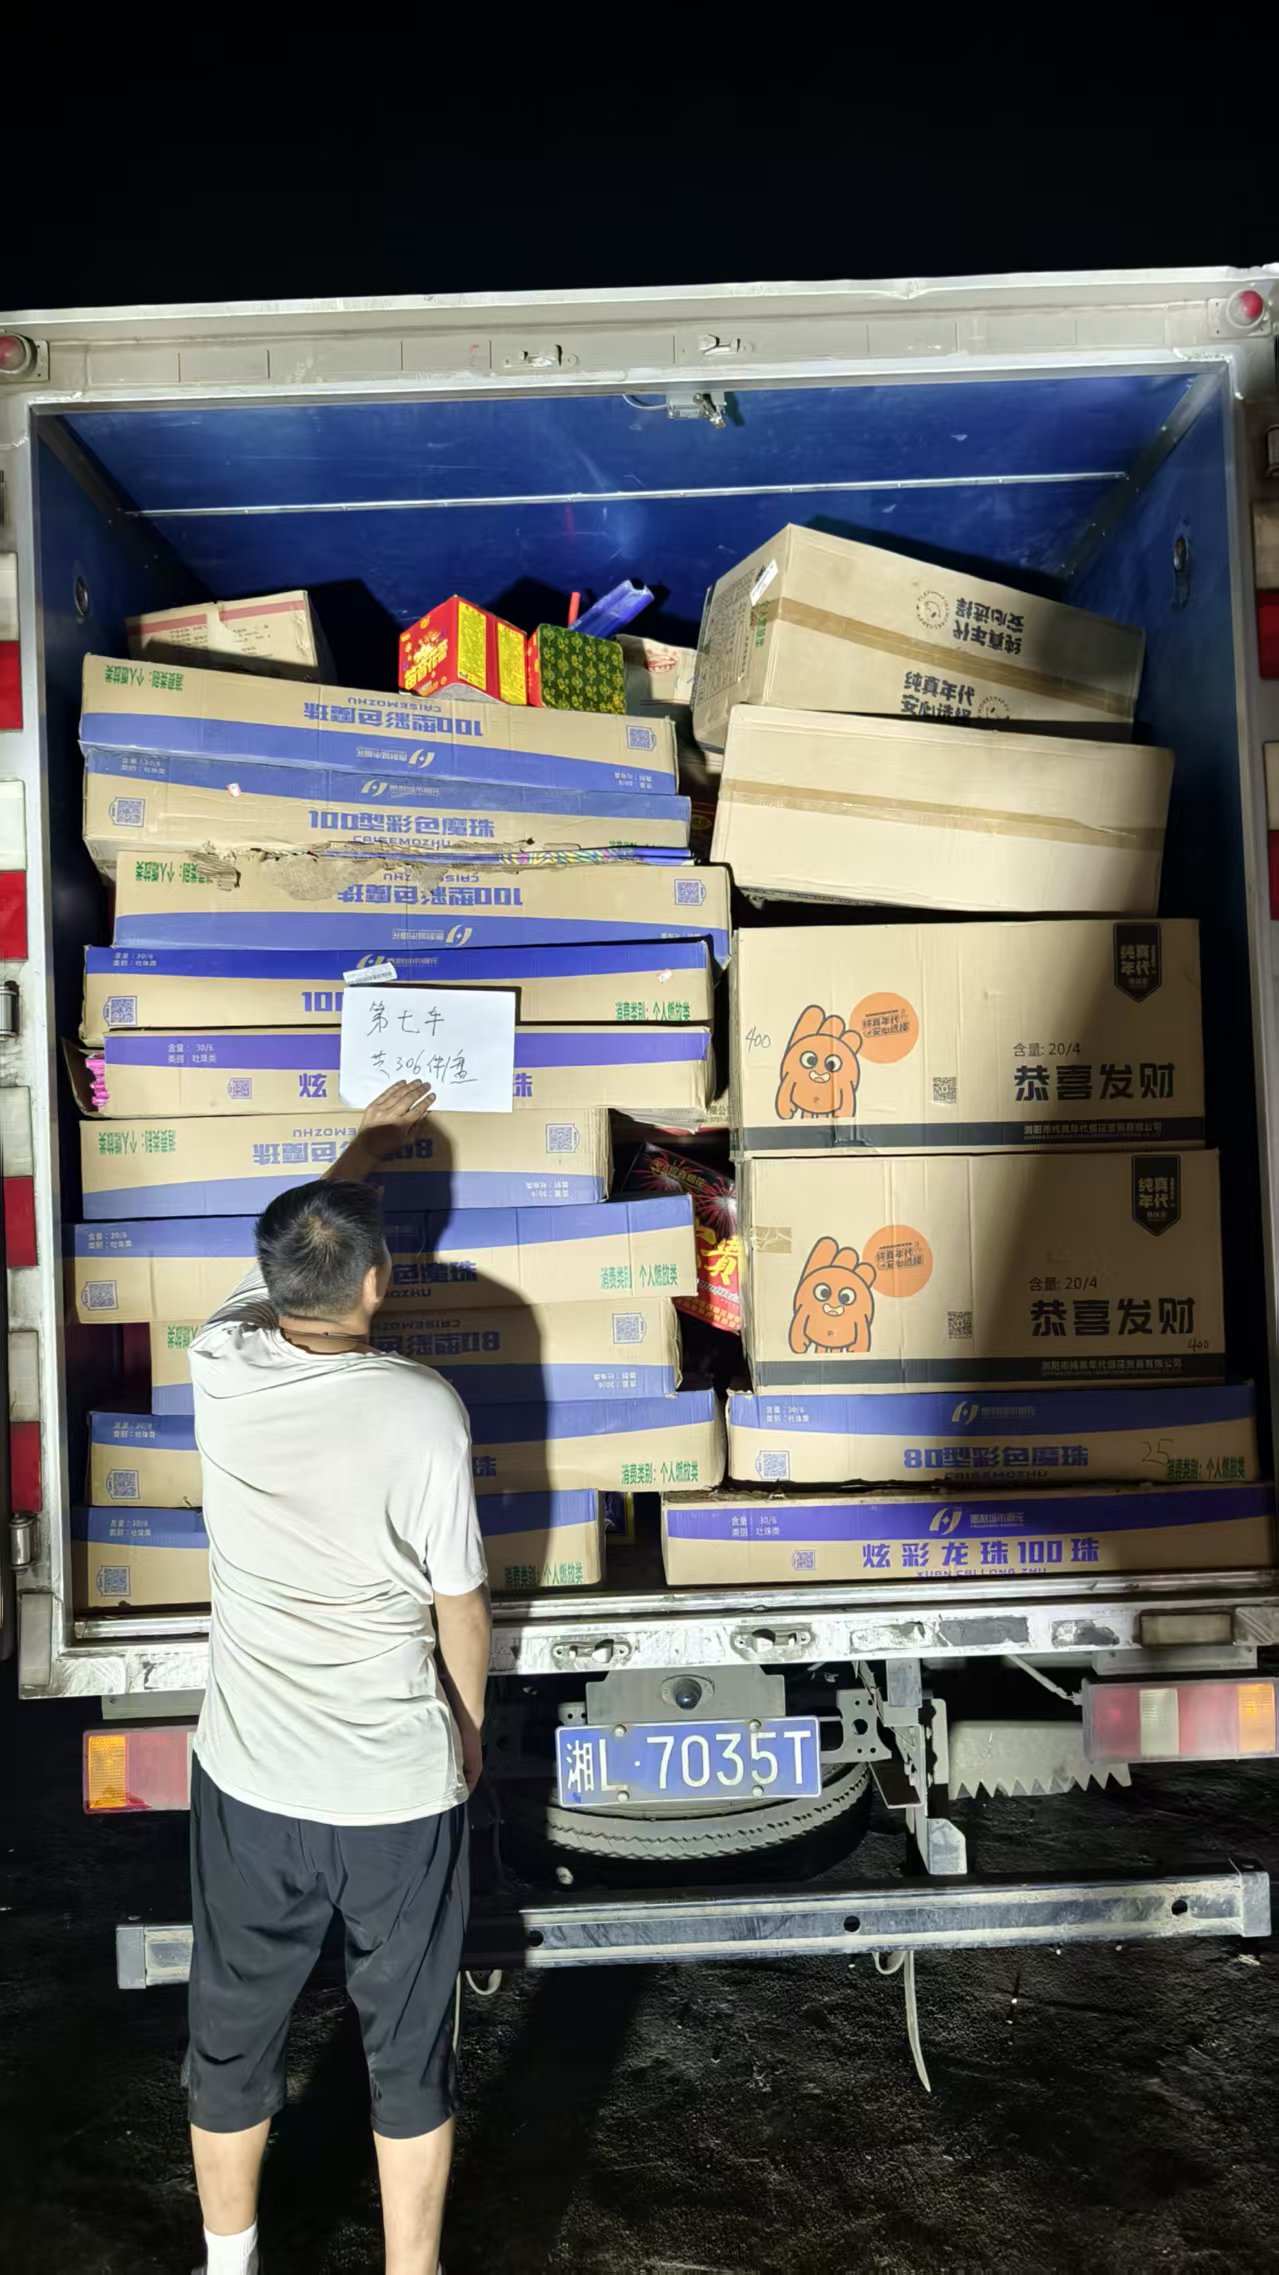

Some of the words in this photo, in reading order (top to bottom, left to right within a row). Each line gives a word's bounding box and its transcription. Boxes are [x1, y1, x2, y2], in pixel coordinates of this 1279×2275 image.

[956, 596, 1025, 633] 安心选择
[952, 620, 1023, 656] 纯真年代
[903, 671, 976, 707] 纯真年代
[303, 702, 483, 737] 100型彩色魔珠
[308, 810, 495, 838] 100型彩色魔珠
[745, 1026, 772, 1050] 400
[1048, 1042, 1081, 1056] 20/4
[1014, 1063, 1174, 1102] 恭喜发财
[1064, 1276, 1098, 1290] 20/4
[1030, 1298, 1195, 1337] 恭喜发财
[904, 1446, 1089, 1469] 80型彩色魔珠
[1141, 1439, 1179, 1465] 25
